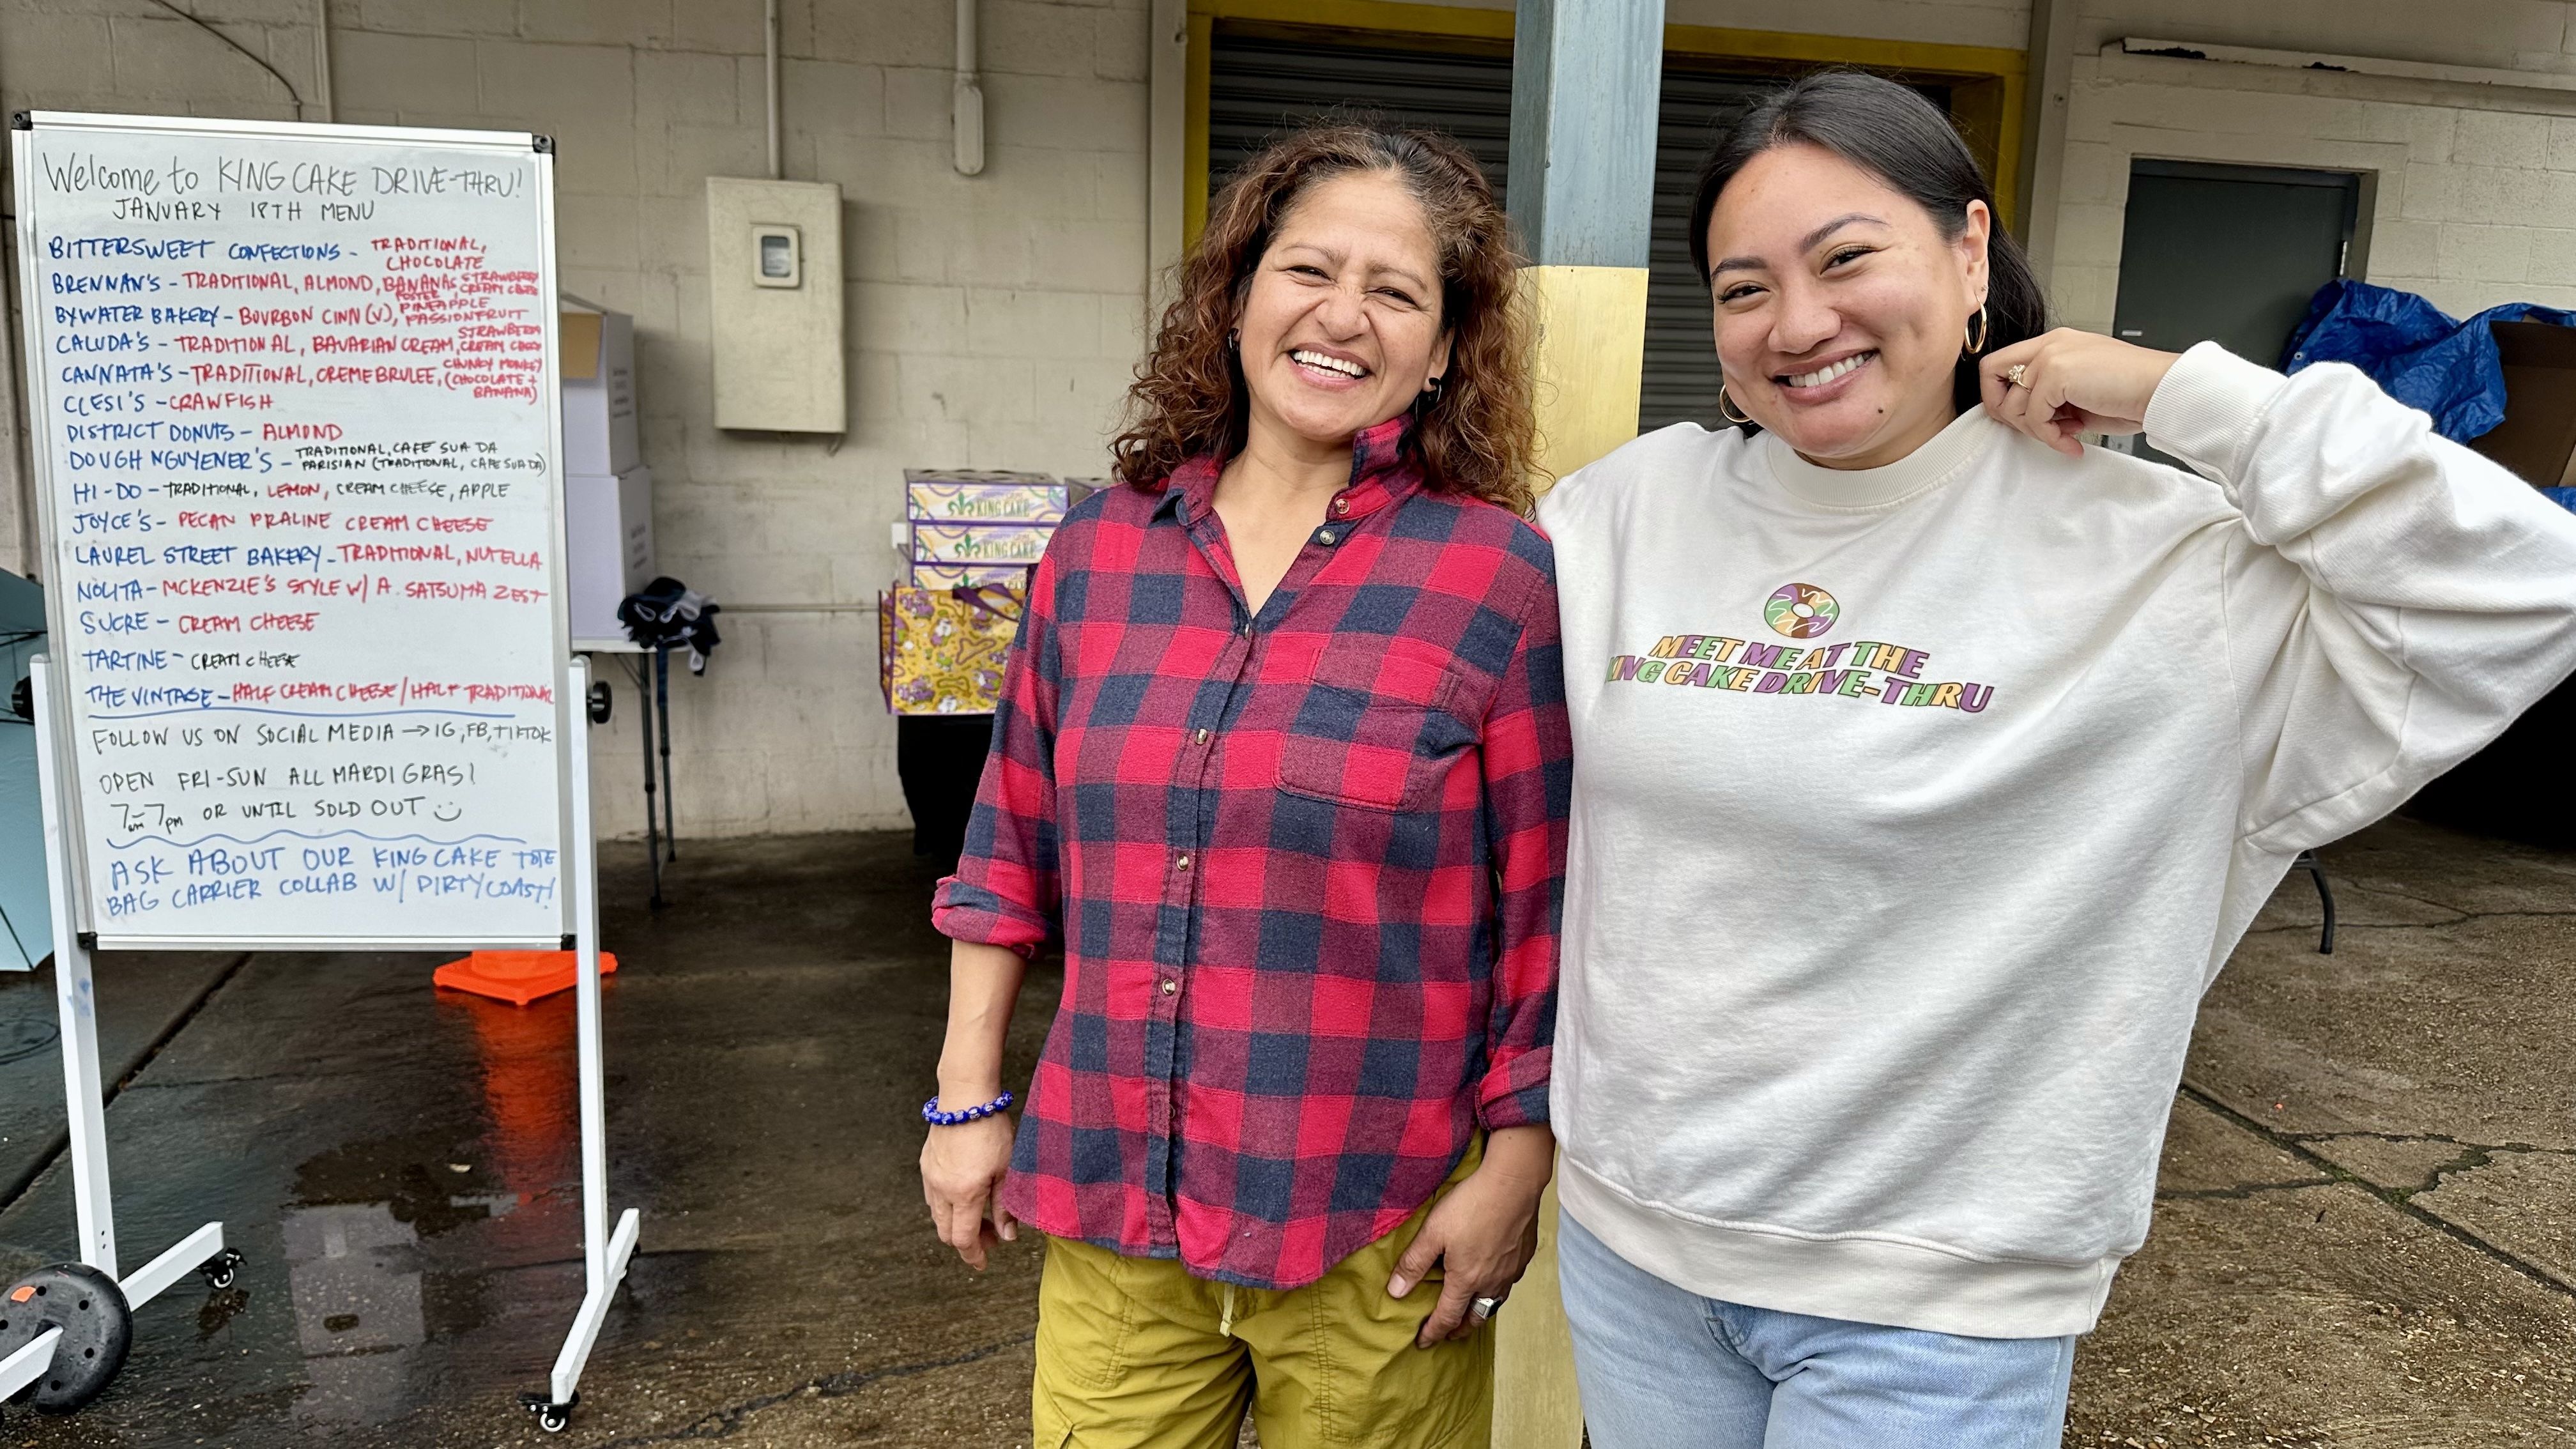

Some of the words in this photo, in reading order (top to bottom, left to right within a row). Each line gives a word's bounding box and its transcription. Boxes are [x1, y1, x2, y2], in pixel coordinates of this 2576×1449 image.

[43, 152, 160, 195] Welcome
[167, 156, 199, 195] to
[219, 156, 286, 192] KING
[293, 162, 357, 195] CAKE
[372, 166, 522, 199] DRIVE-THRU!
[112, 197, 222, 222] JANUARY
[251, 200, 302, 222] 18TH
[321, 200, 374, 222] MENU
[49, 236, 216, 260] BITTERSWEET
[228, 243, 340, 262] CONFECTIONS
[371, 236, 487, 254] TRADITIONAL,
[386, 256, 485, 272] CHOCOLATE
[52, 273, 161, 295] BRENNAN'S
[181, 272, 298, 295] TRADITIONAL,
[56, 305, 144, 327] BYWATER
[151, 305, 220, 328] BAKERY
[239, 307, 313, 327] BOURBON
[322, 308, 360, 326] CINN
[405, 309, 529, 326] PASSIONFRUIT
[400, 297, 491, 314] PINEAPPLE
[56, 331, 150, 354] CALUDA'S
[313, 335, 397, 355] BAVARIAN
[63, 362, 172, 384] CANNATA'S
[190, 363, 313, 387] TRADITIONAL,
[317, 366, 371, 383] CREME
[169, 393, 274, 412] CRAWFISH
[66, 421, 165, 443] DISTRICT
[170, 424, 234, 443] DONUTS
[263, 423, 343, 442] ALMOND
[70, 450, 143, 471] DOUGH
[151, 447, 272, 473] NGUYENER'S
[440, 441, 471, 452] SUA
[475, 441, 498, 453] DA
[302, 456, 366, 471] PARISIAN
[337, 482, 384, 496] CREAM
[459, 482, 511, 500] APPLE
[73, 508, 152, 534] JOYCE'S
[178, 511, 236, 531] PECAN
[250, 511, 333, 530] PRALINE
[346, 514, 410, 532] CREAM
[417, 516, 494, 534] CHEESE
[75, 546, 155, 567] LAUREL
[164, 545, 238, 565] STREET
[247, 545, 321, 572] BAKERY
[466, 547, 543, 572] NUTELLA
[287, 578, 341, 596] STYLE
[405, 580, 487, 601] SATSUMA
[493, 585, 549, 603] ZEST
[80, 611, 150, 634] SUCRE
[179, 615, 241, 634] CREAM
[250, 612, 320, 631] CHEESE
[82, 649, 169, 671] TARTINE
[192, 652, 240, 671] CREAM
[1648, 634, 1745, 662] MEET
[1738, 642, 1804, 670] ME
[1795, 642, 1852, 671] AT
[1850, 641, 1930, 679] THE
[85, 684, 126, 709] THE
[132, 686, 214, 708] VINTAGE
[233, 682, 276, 703] HALF
[280, 682, 332, 700] CREAM
[464, 684, 555, 705] TRADITIONAL
[1664, 661, 1760, 692] CAKE
[1753, 669, 1995, 713] DRIVE-THRU
[93, 726, 169, 755] FOLLOW
[183, 728, 203, 746] US
[214, 724, 241, 744] ON
[257, 723, 319, 746] SOCIAL
[328, 723, 394, 743] MEDIA
[99, 771, 154, 795] OPEN
[289, 767, 324, 786] ALL
[333, 763, 394, 786] MARDI
[203, 802, 227, 821] OR
[241, 802, 297, 818] UNTIL
[314, 799, 361, 818] SOLD
[371, 796, 426, 816] OUT
[111, 855, 174, 891] ASK
[188, 847, 286, 875] ABOUT
[303, 847, 354, 871] OUR
[374, 848, 427, 869] KING
[434, 847, 502, 868] CAKE
[512, 848, 557, 869] TOTE
[107, 891, 160, 917] BAG
[172, 878, 262, 909] CARRIER
[279, 873, 357, 896] COLLAB
[374, 868, 406, 903] W/
